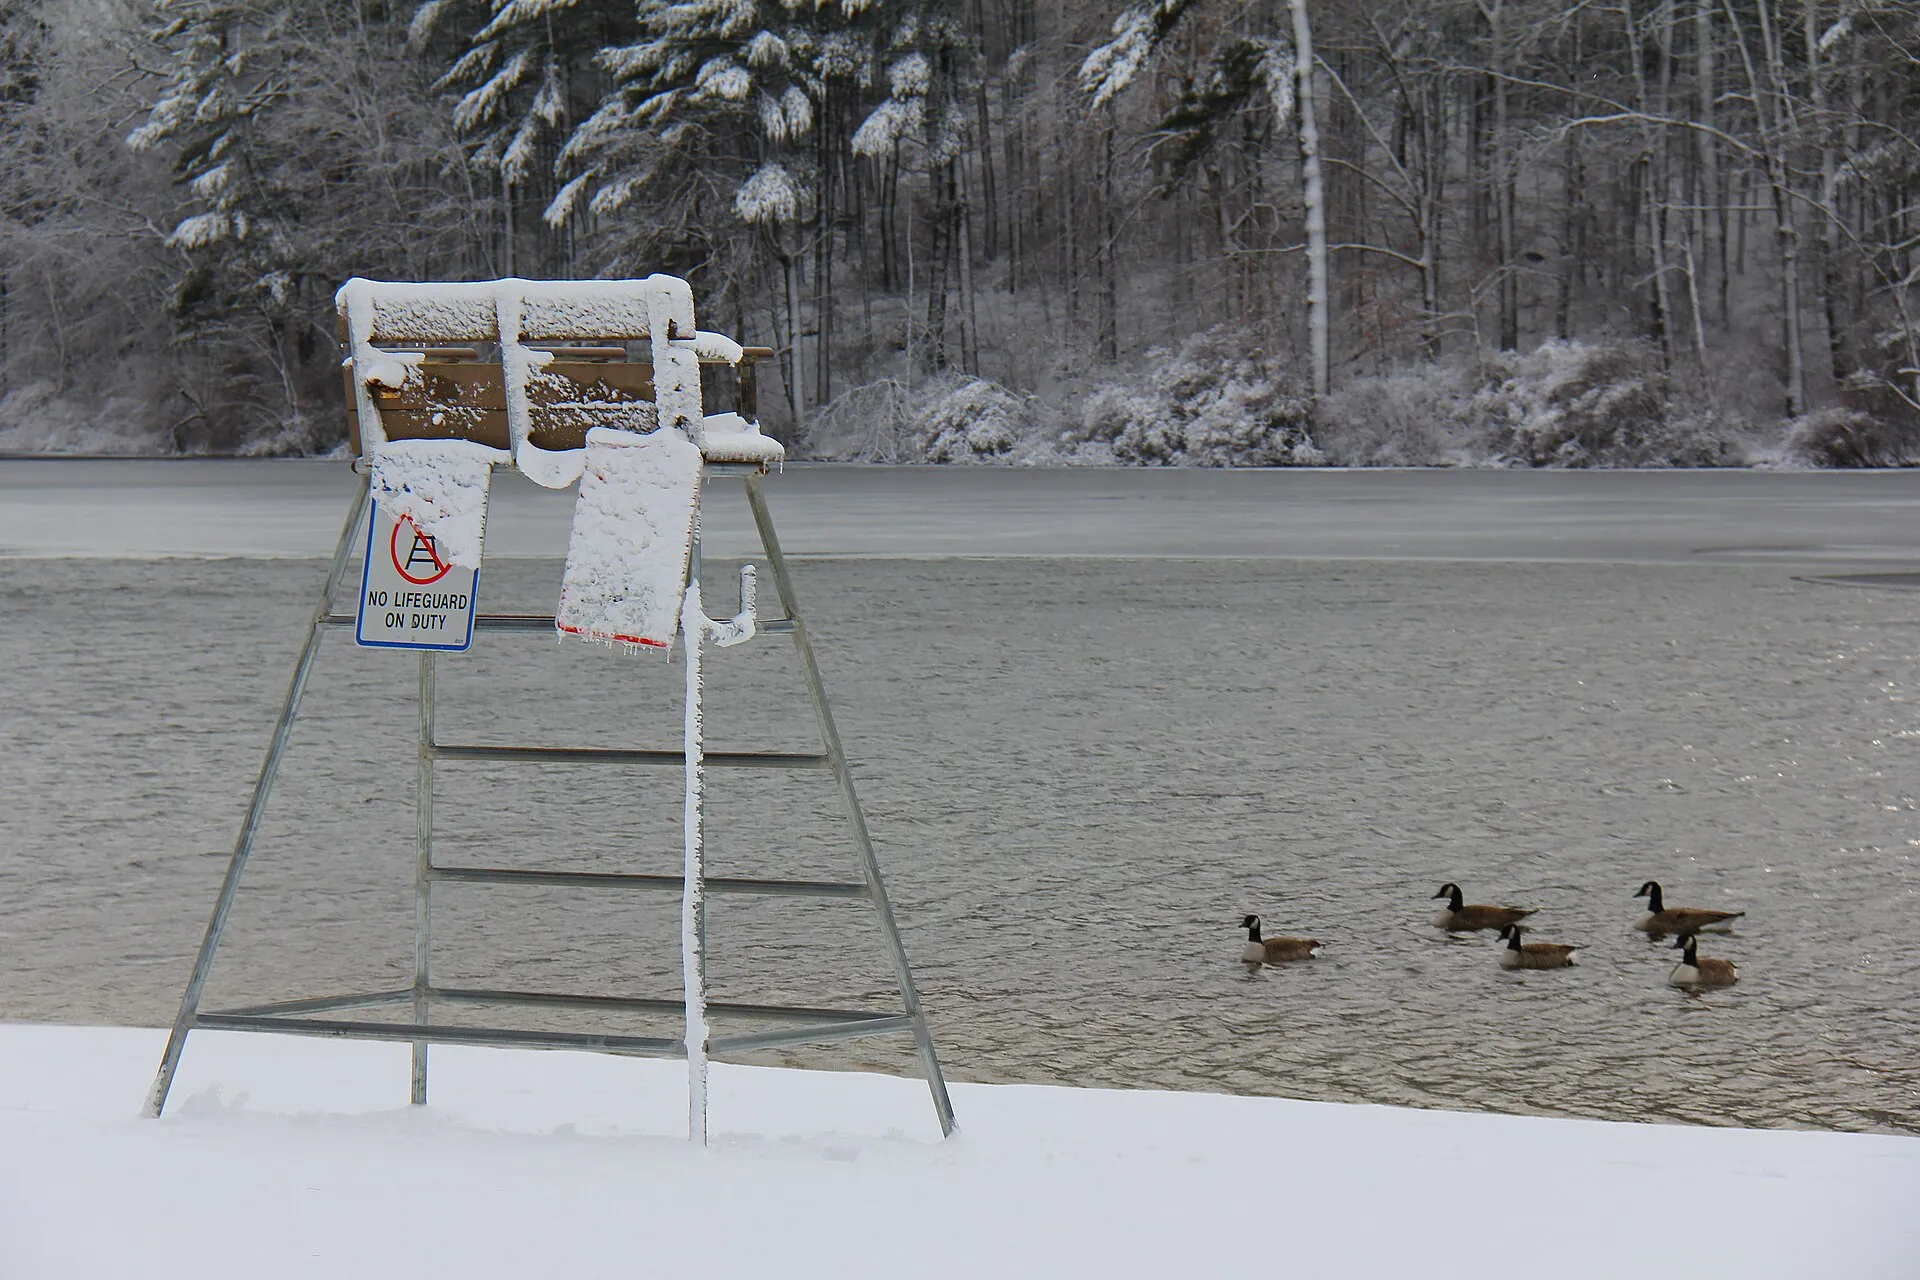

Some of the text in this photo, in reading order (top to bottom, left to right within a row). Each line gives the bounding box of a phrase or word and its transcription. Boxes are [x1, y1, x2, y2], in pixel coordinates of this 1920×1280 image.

[368, 591, 467, 609] NO LIFEGUARD
[385, 612, 446, 629] ON DUTY
